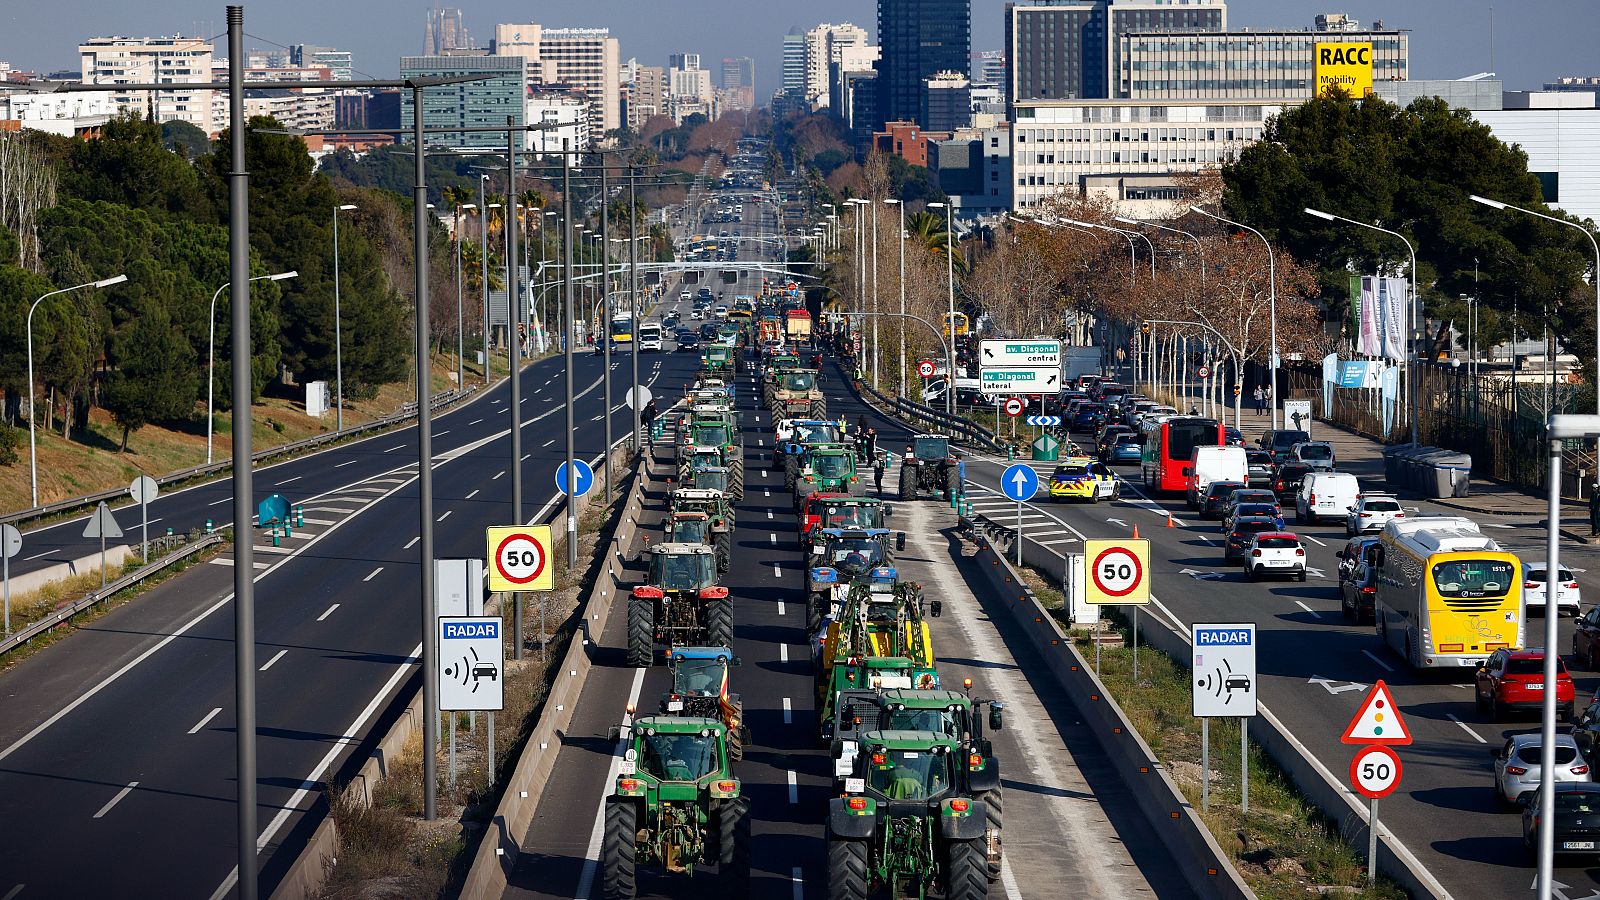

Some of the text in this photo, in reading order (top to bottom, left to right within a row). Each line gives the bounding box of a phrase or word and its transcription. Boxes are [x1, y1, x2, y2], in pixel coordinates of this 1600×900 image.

[1320, 47, 1369, 65] RACC
[1320, 75, 1357, 85] Mobility
[1021, 345, 1058, 353] Diagonal
[998, 373, 1035, 381] Diagonal
[507, 550, 535, 567] 50
[1103, 563, 1132, 580] 50
[447, 625, 495, 637] RADAR
[1200, 631, 1249, 643] RADAR
[1362, 763, 1390, 780] 50
